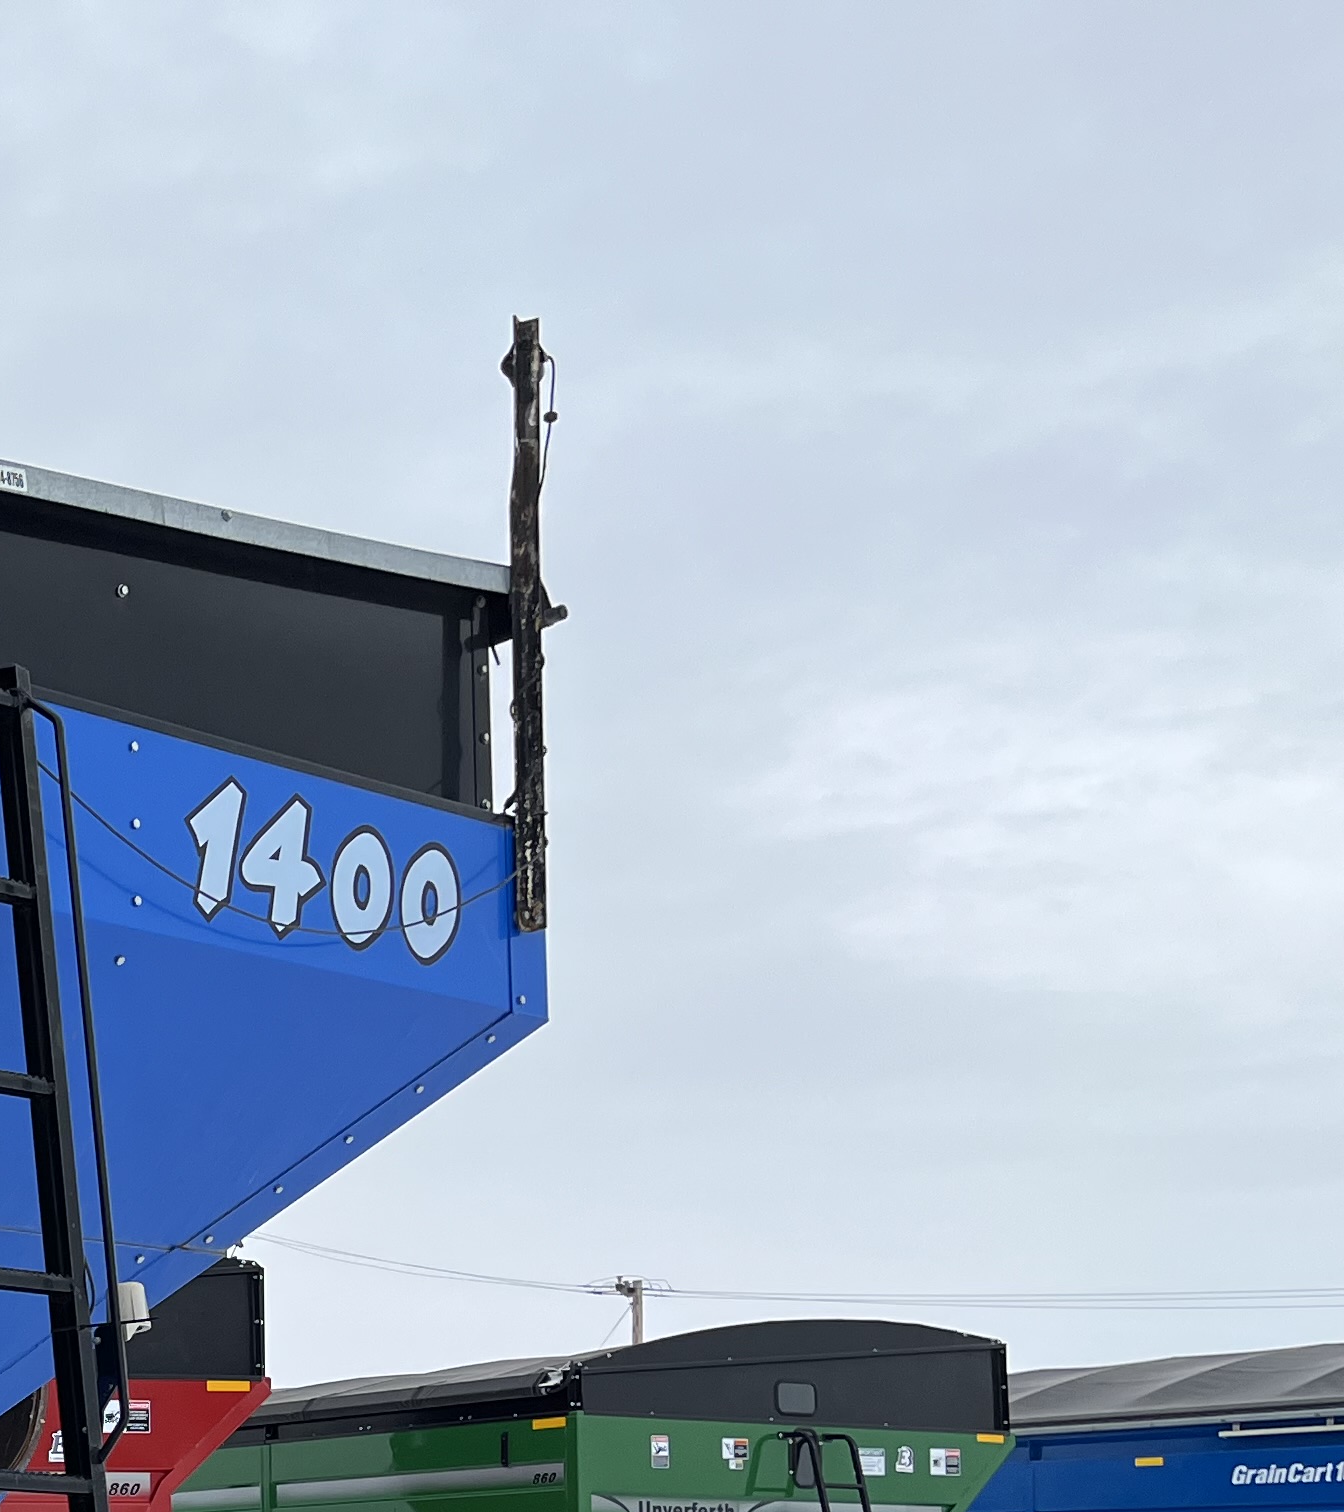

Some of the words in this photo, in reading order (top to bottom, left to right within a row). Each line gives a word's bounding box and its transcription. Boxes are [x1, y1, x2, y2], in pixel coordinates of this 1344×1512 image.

[184, 775, 460, 966] 1400
[532, 1473, 557, 1485] 860
[1231, 1463, 1333, 1485] GrainCart
[109, 1483, 141, 1496] 860
